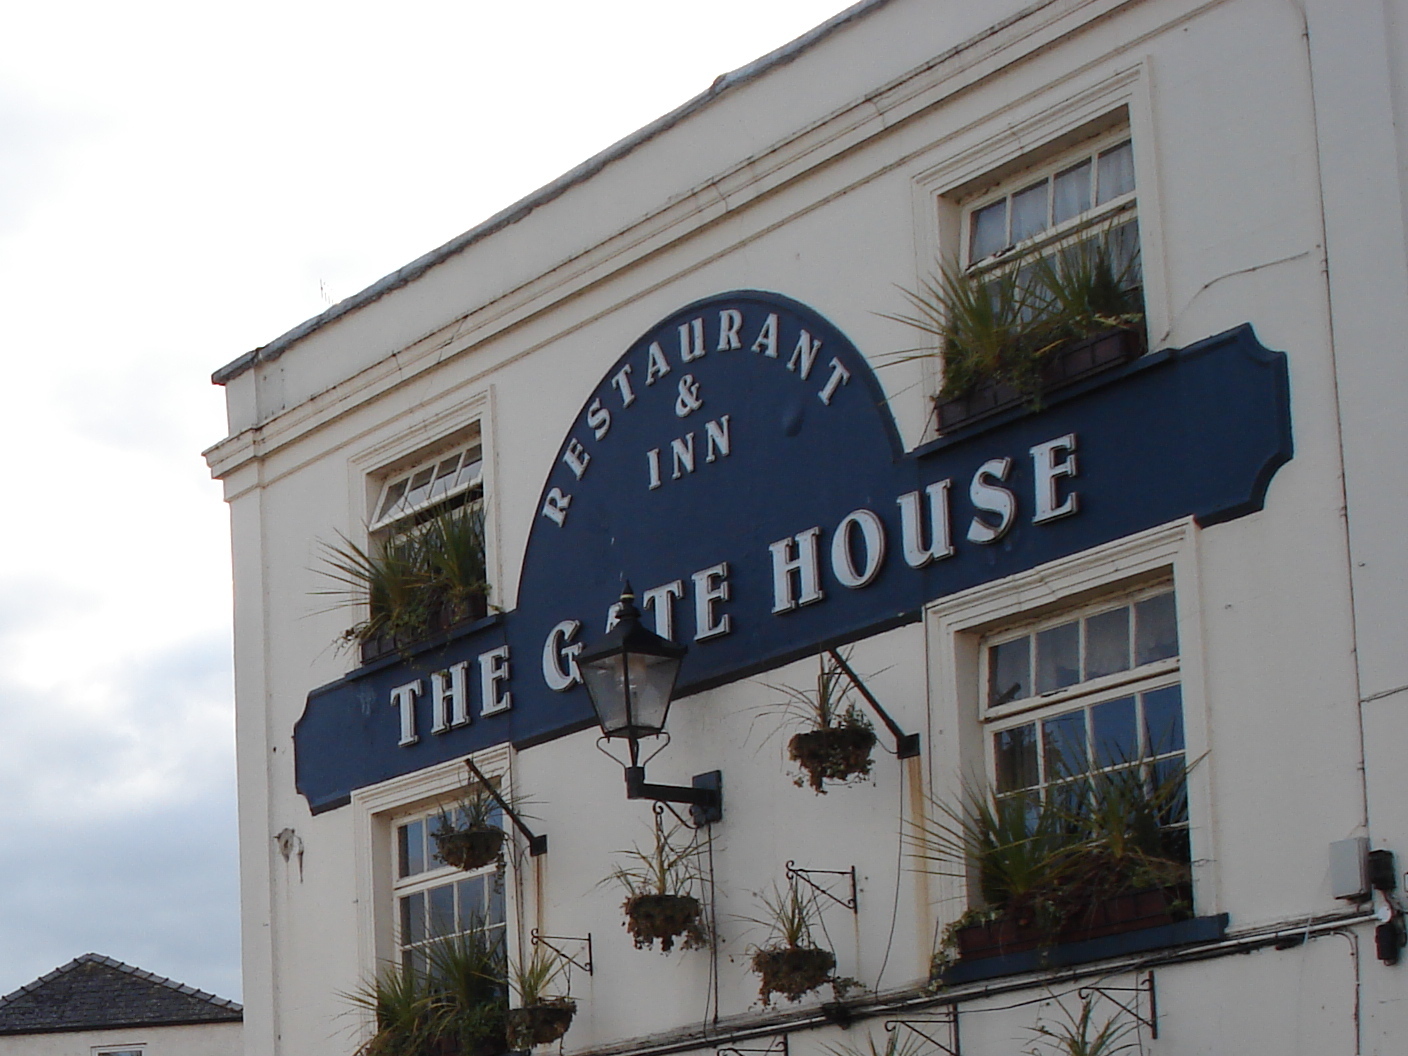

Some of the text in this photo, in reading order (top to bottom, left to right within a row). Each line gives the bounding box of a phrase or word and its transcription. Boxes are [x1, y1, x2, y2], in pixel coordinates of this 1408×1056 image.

[543, 309, 851, 528] RESTAURANT
[646, 415, 731, 491] INN
[675, 373, 703, 418] &
[390, 644, 513, 748] THE
[768, 433, 1079, 614] HOUSE
